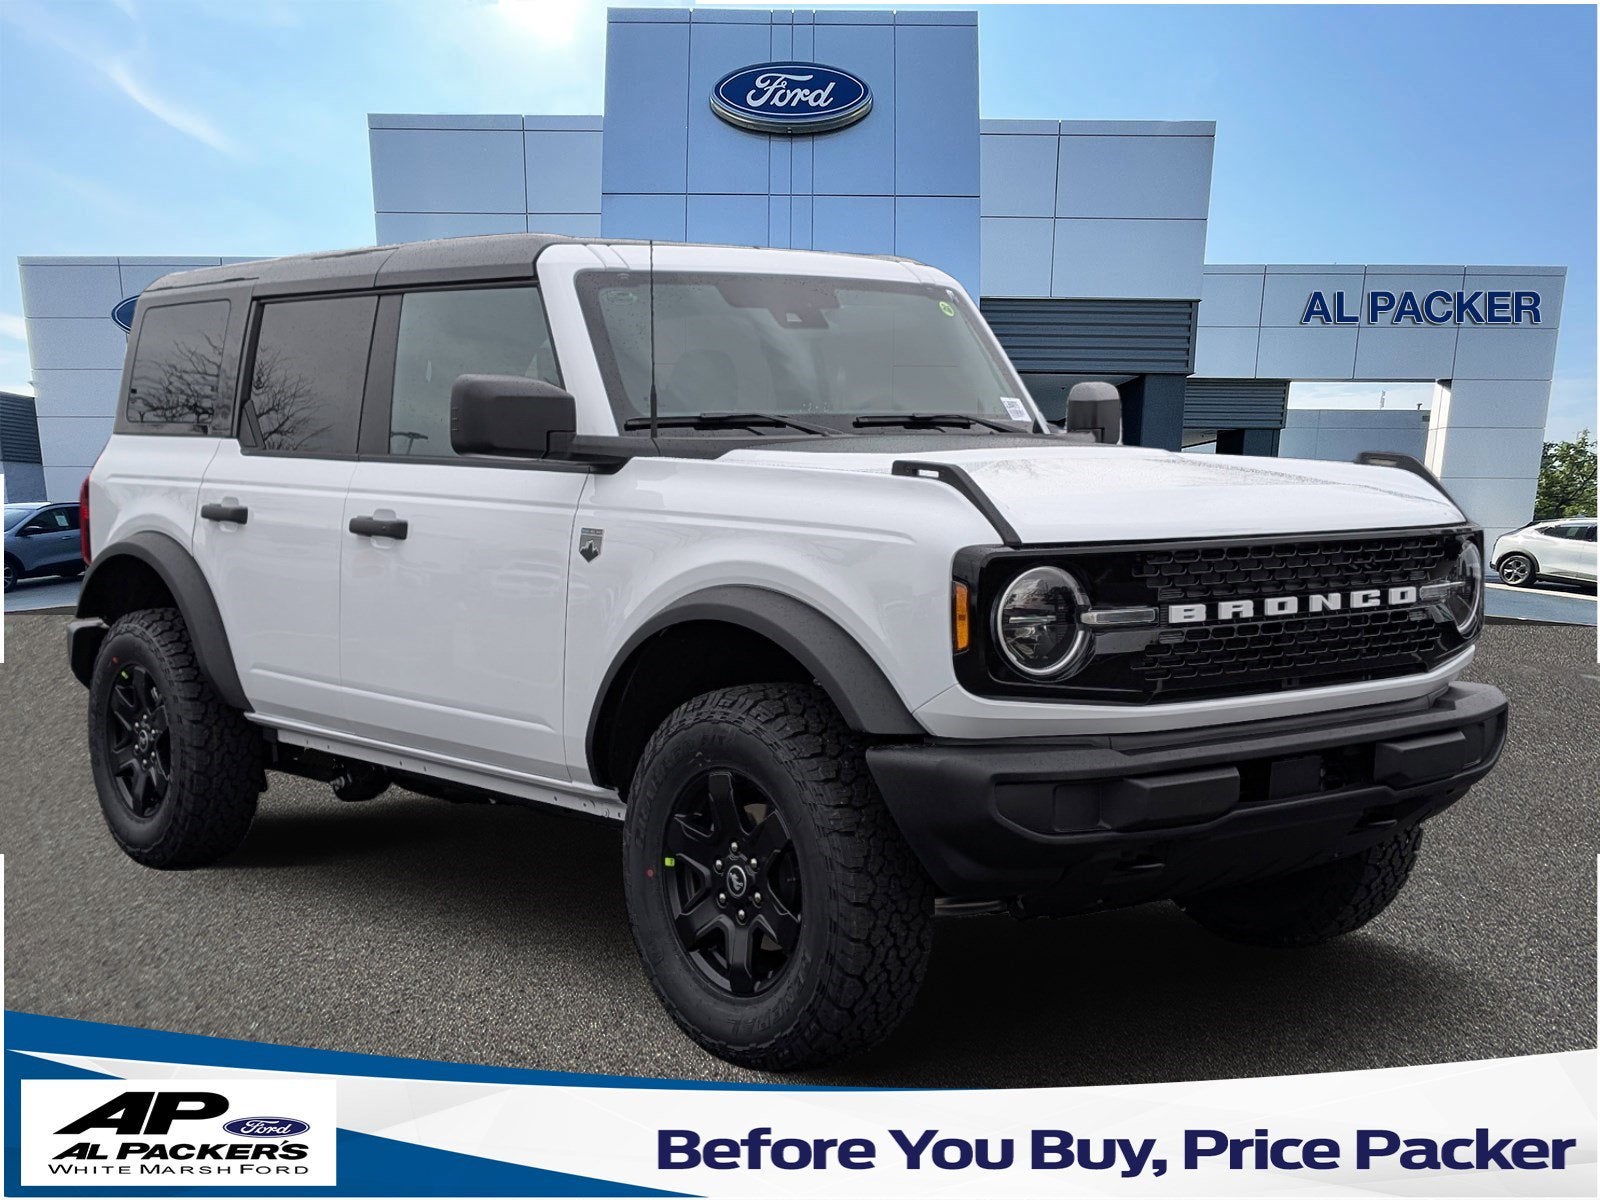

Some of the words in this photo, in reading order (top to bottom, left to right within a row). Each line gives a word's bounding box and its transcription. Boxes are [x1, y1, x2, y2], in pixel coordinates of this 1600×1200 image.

[746, 73, 836, 107] Ford
[1302, 290, 1359, 324] AL
[1369, 290, 1542, 325] PACKER
[1168, 586, 1417, 624] BRONCO
